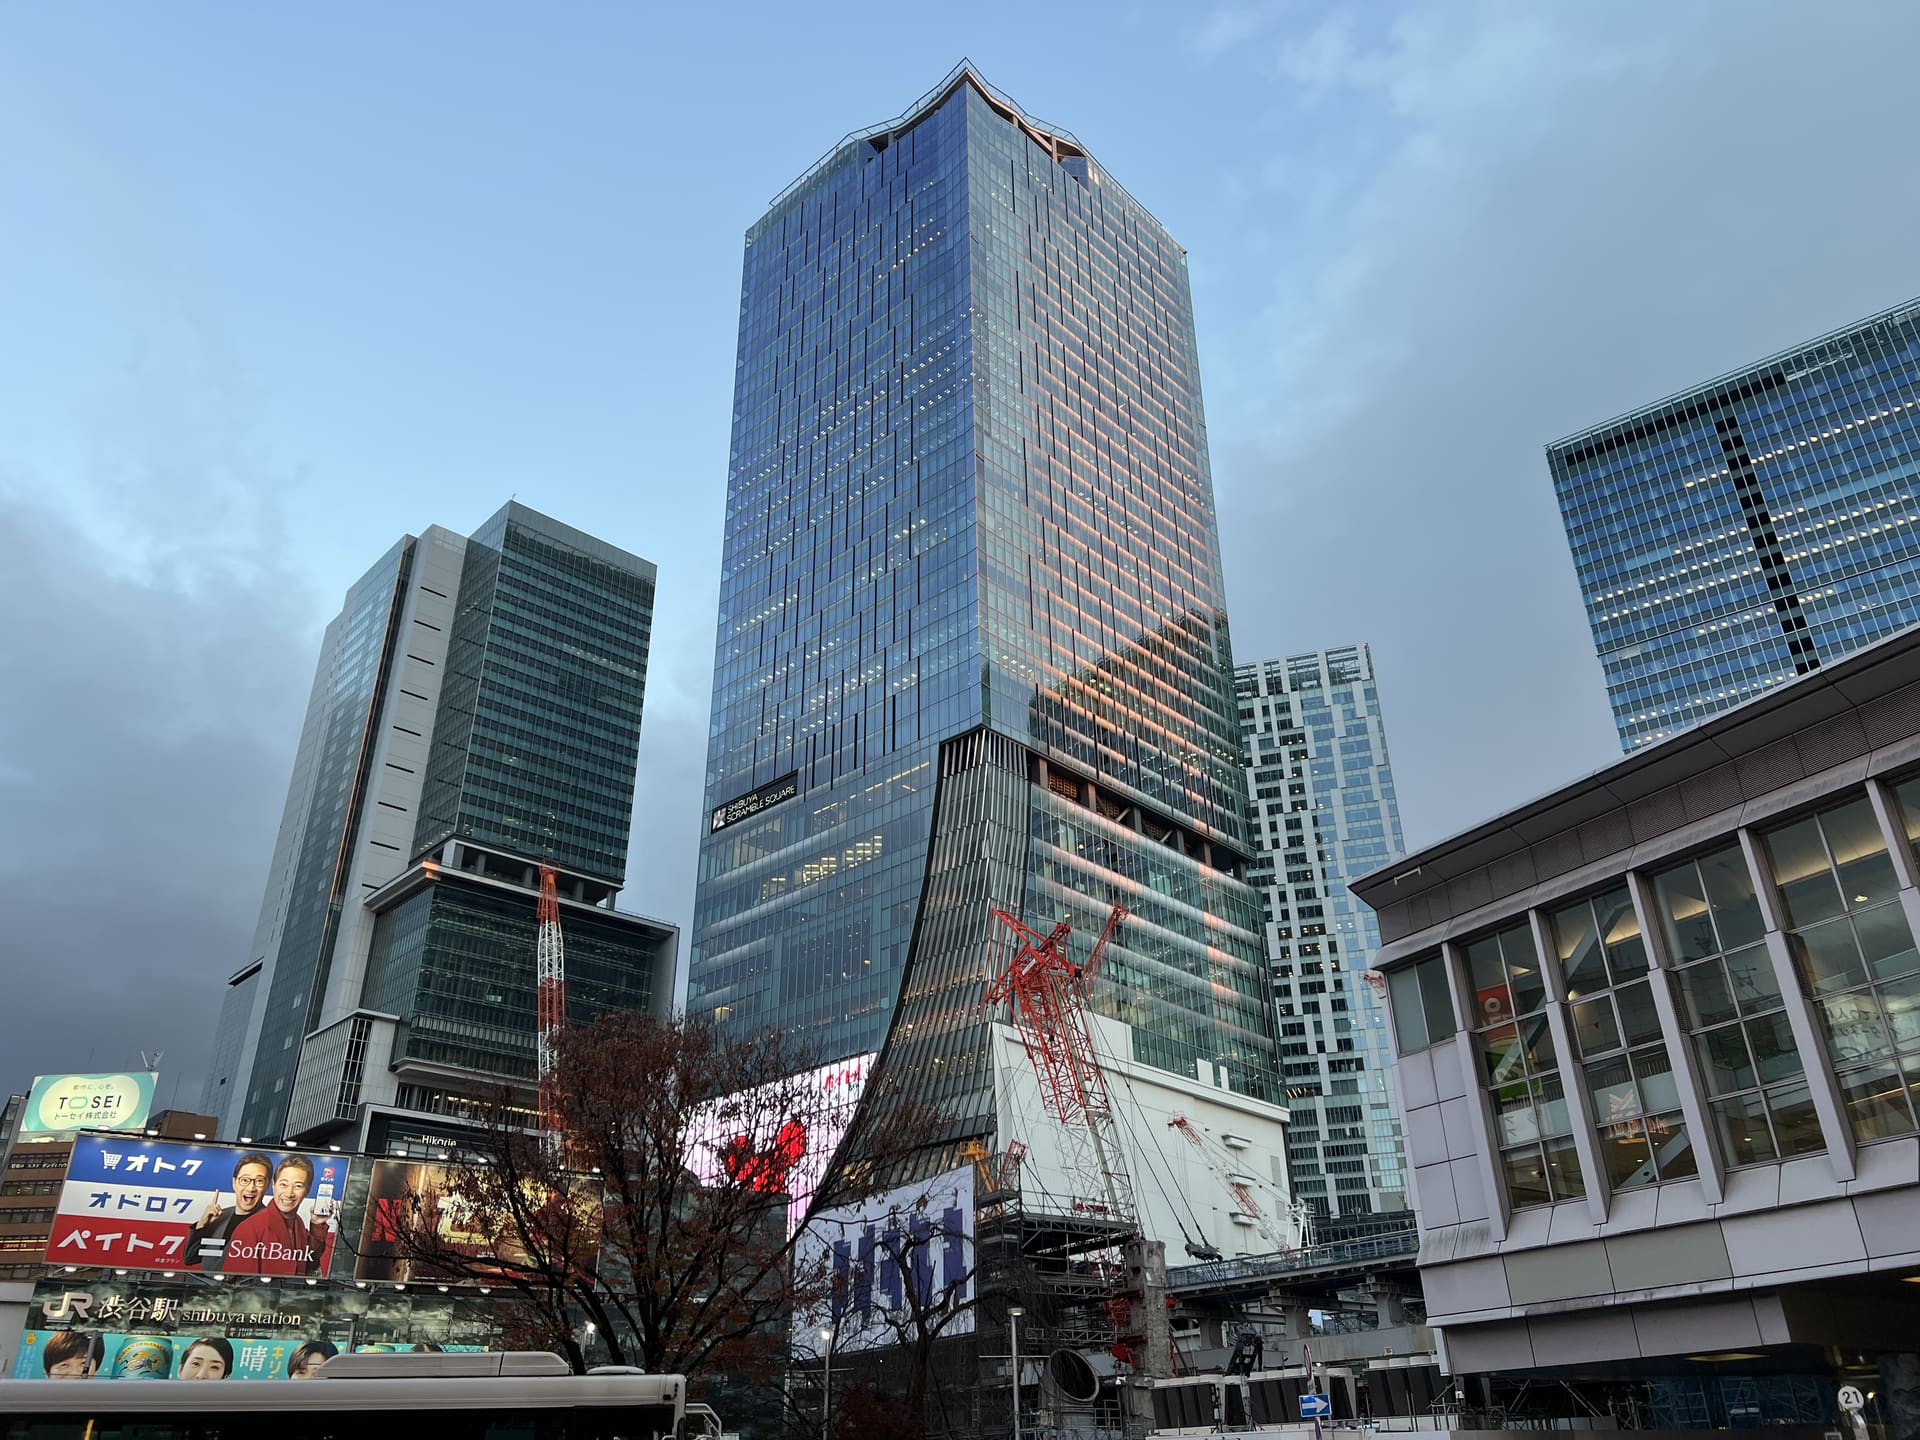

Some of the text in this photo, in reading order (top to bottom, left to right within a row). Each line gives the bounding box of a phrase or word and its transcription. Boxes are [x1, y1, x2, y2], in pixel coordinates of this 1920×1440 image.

[726, 784, 795, 823] SCRAMBLE SQUARE
[727, 793, 758, 814] SHIBUYA
[59, 1095, 122, 1109] TOSEI
[54, 1111, 117, 1121] トーセイ株式会社
[421, 1135, 457, 1147] Hikarie
[125, 1154, 203, 1176] オトク
[88, 1192, 194, 1215] オドロク
[57, 1228, 187, 1256] ペイトク
[228, 1239, 315, 1263] SoftBank
[43, 1291, 94, 1321] JR
[98, 1294, 178, 1323] 渋谷駅
[182, 1309, 302, 1327] shibuya station
[1842, 1390, 1861, 1405] 21
